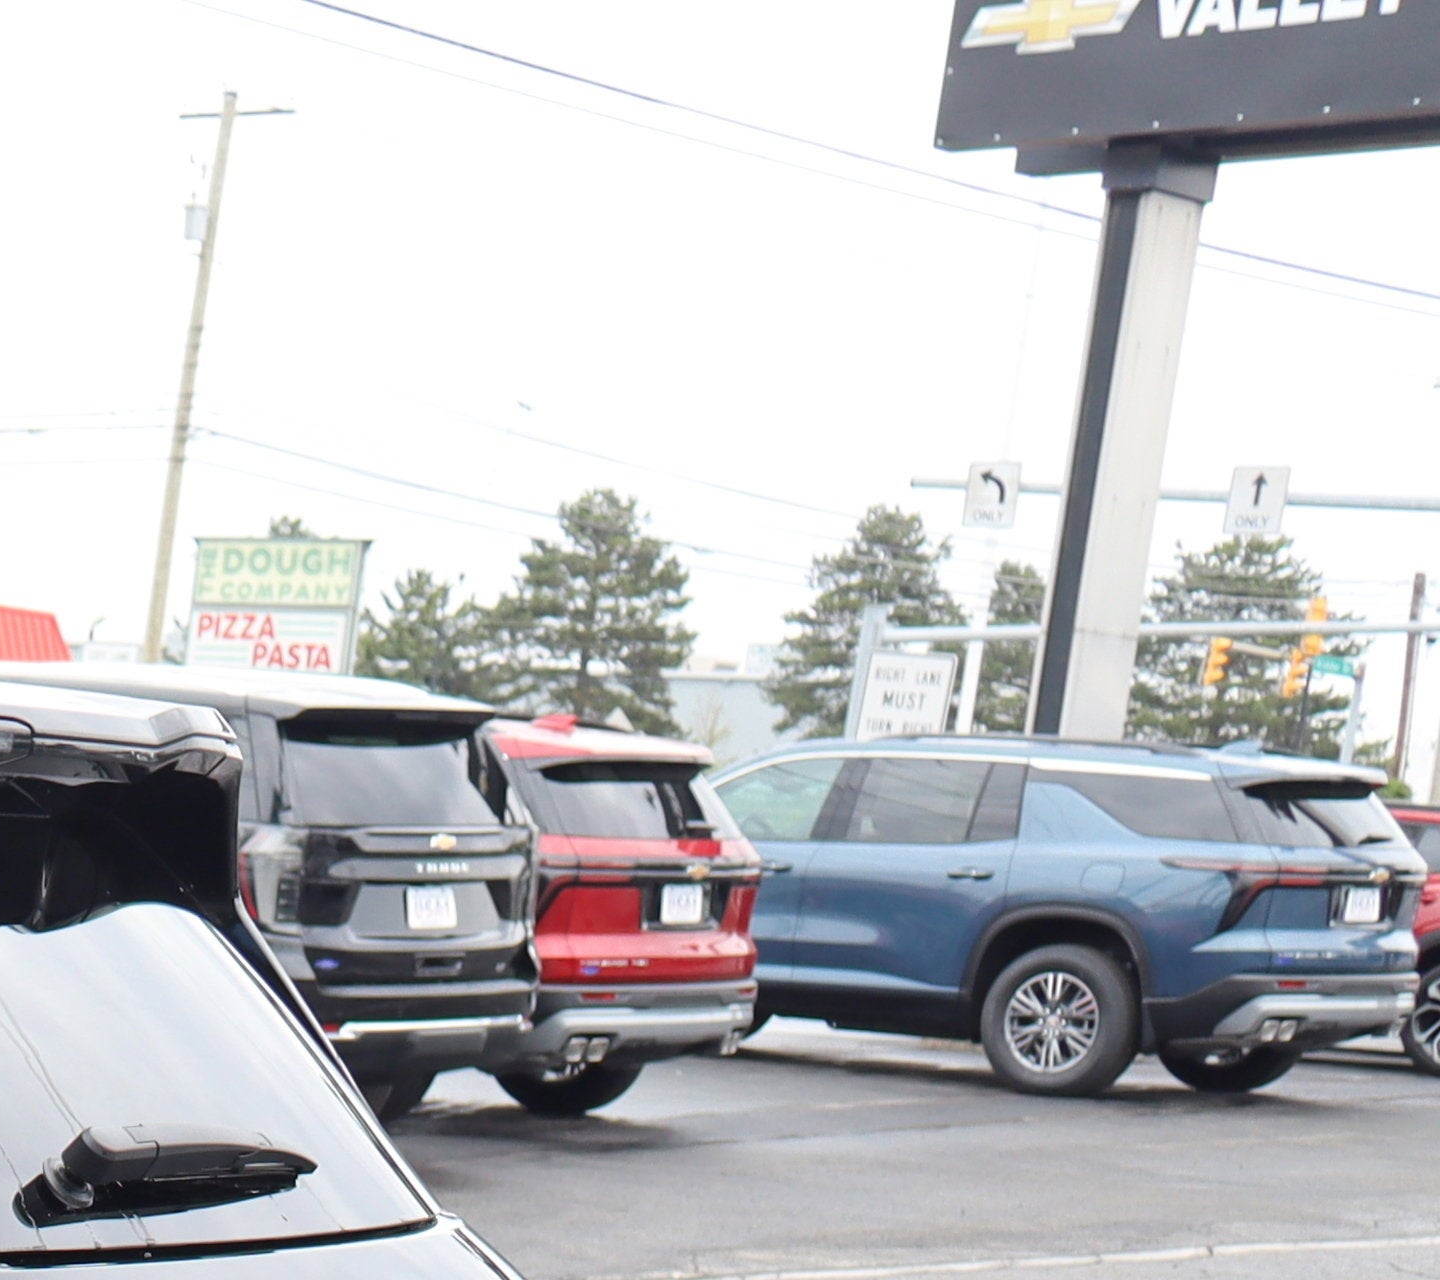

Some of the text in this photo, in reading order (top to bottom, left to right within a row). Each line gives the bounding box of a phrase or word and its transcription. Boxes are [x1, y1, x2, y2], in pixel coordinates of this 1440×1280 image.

[973, 509, 1004, 523] ONLY
[1234, 514, 1270, 529] ONLY
[198, 549, 218, 596] THE
[221, 547, 350, 576] DOUGH
[219, 581, 350, 600] COMPANY
[197, 612, 275, 640] PIZZA
[251, 642, 331, 670] PASTA
[882, 690, 927, 711] MUST
